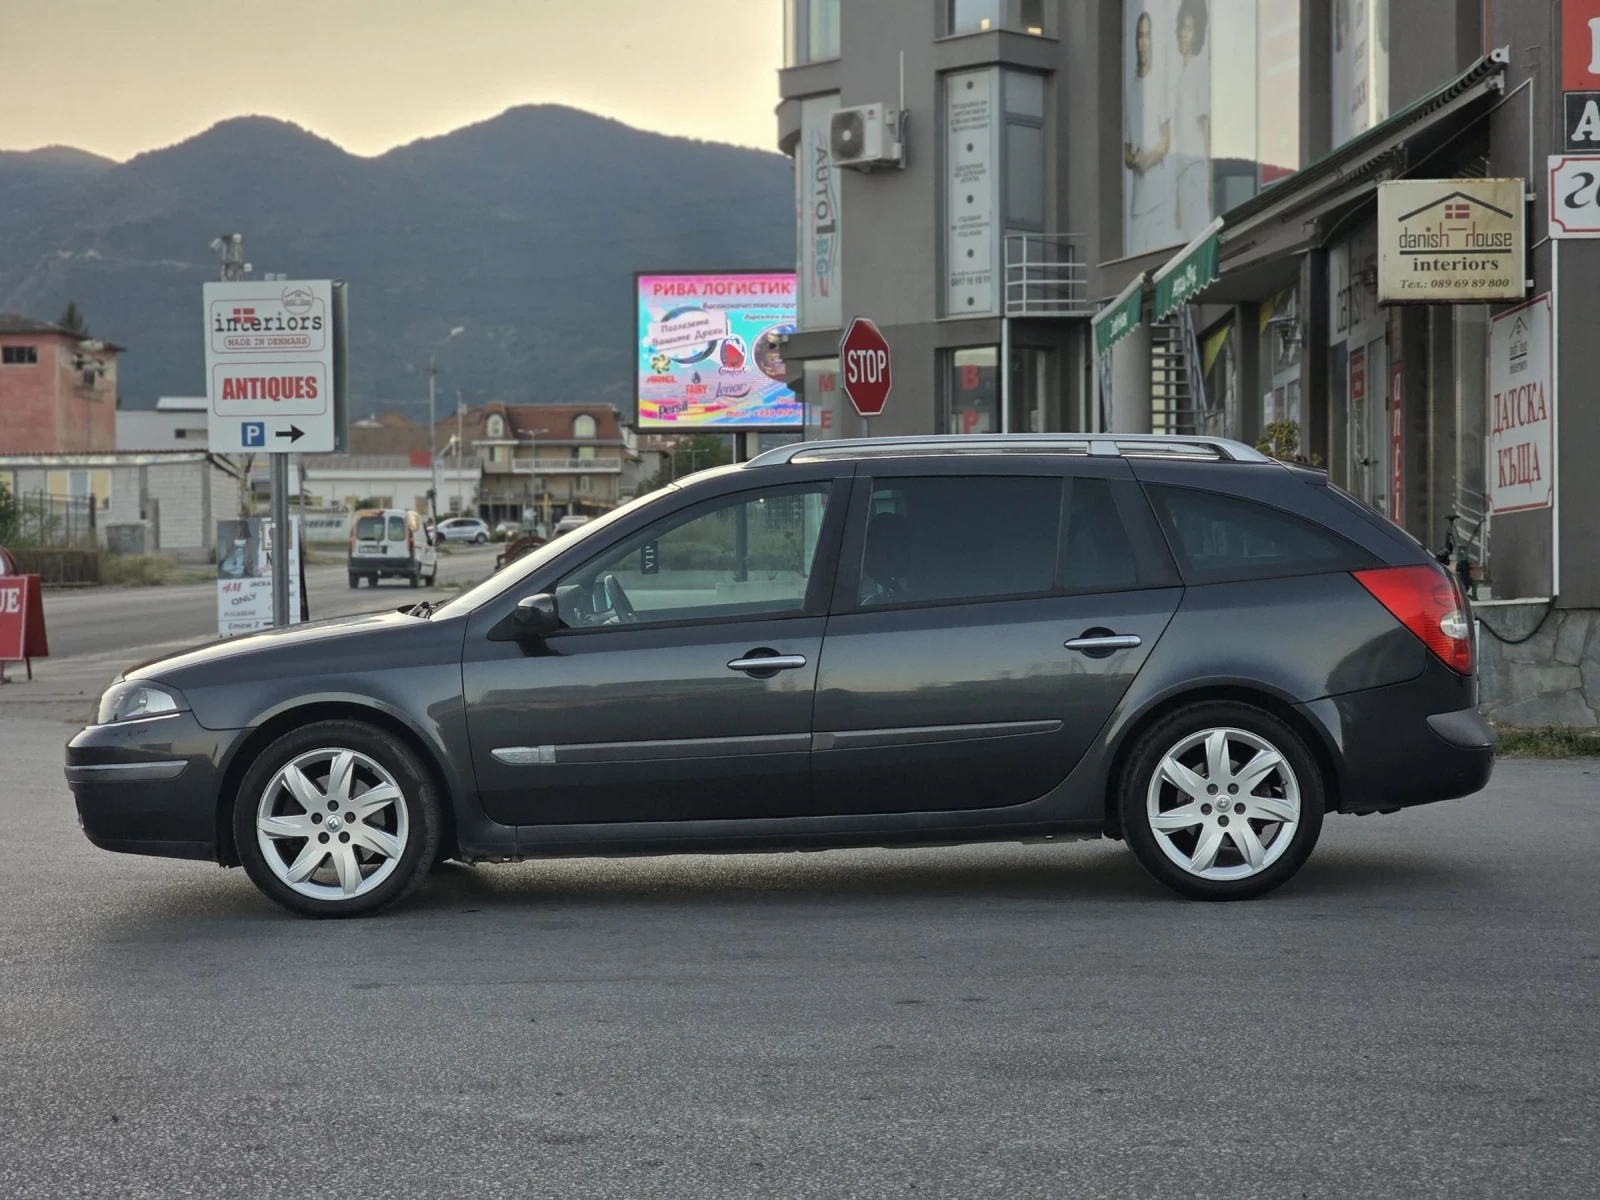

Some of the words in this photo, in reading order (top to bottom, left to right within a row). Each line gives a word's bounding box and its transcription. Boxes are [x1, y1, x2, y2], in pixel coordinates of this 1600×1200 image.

[1413, 257, 1499, 271] interiors
[653, 283, 697, 296] РИВА
[1431, 280, 1452, 288] 089
[1454, 279, 1469, 288] 69
[1471, 279, 1486, 288] 89
[1488, 278, 1510, 287] 800
[215, 312, 323, 332] interiors
[228, 338, 251, 346] MADE
[254, 338, 264, 346] IN
[268, 337, 308, 345] DENMARK
[848, 350, 886, 383] STOP
[647, 375, 676, 383] ARIEL
[222, 376, 318, 401] ANTIQUES
[686, 385, 707, 394] FAIRY
[1492, 379, 1548, 442] ДАТСКА
[246, 425, 260, 444] P
[1498, 441, 1542, 492] КЪЩА
[645, 545, 654, 569] VIP
[231, 592, 257, 606] ONLY
